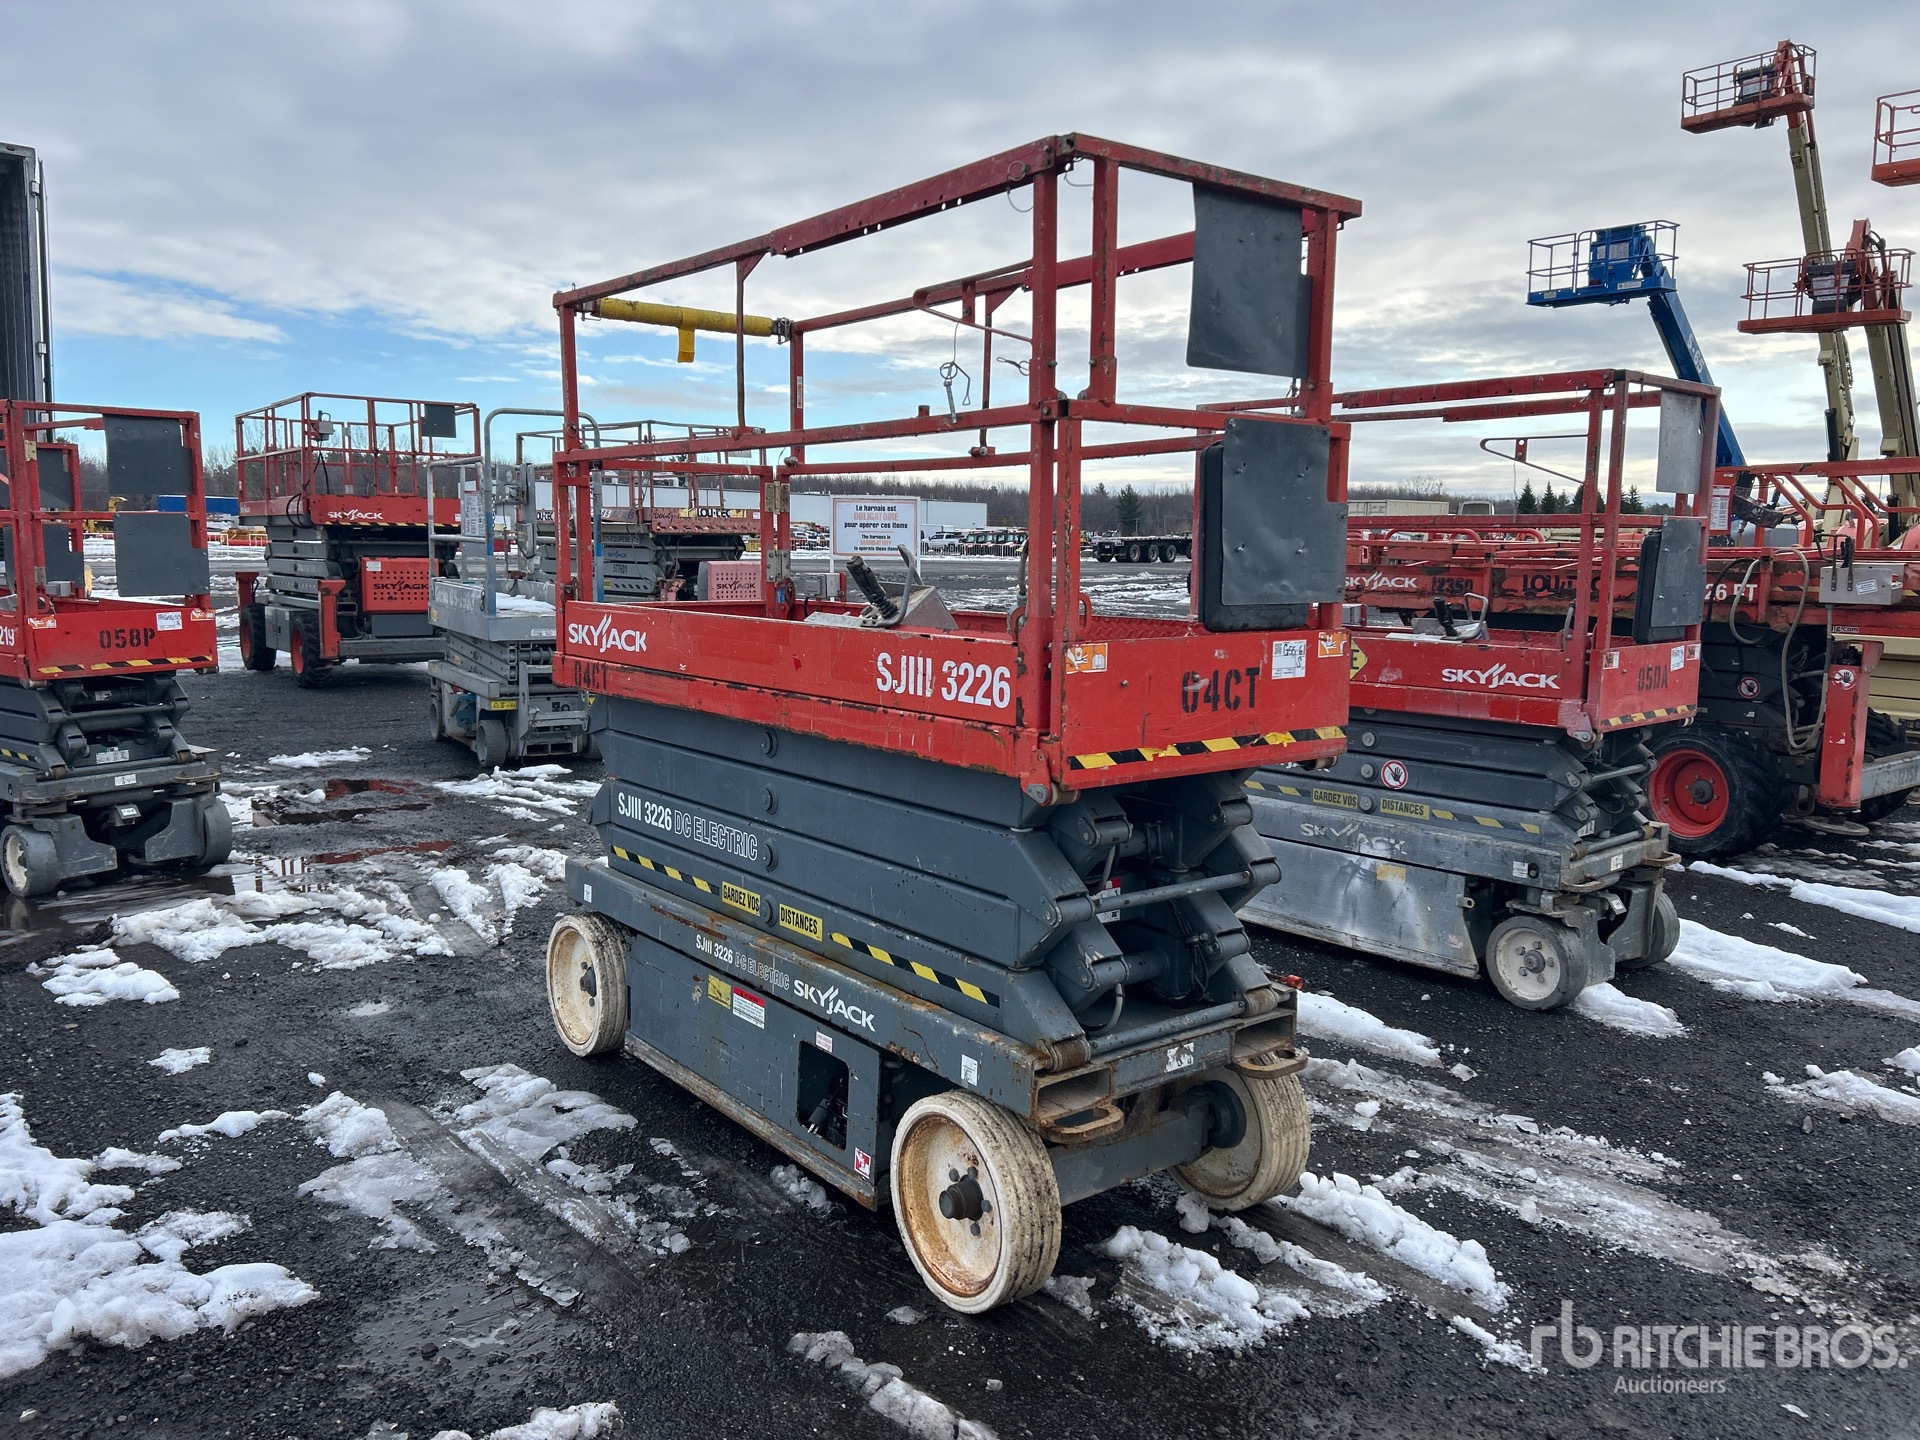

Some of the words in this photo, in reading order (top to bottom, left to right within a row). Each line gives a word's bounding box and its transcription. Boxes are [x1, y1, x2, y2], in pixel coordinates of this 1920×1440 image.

[327, 508, 384, 521] SKYJACK
[854, 512, 899, 521] OBLIGATOIRE
[373, 580, 429, 592] SKYJACK
[716, 581, 756, 591] SKYJACK
[99, 627, 156, 649] 058P
[568, 614, 647, 653] SKYJACK
[876, 652, 933, 698] SJIII
[941, 660, 1011, 709] 3226
[1441, 662, 1561, 690] SKYJACK
[1182, 667, 1261, 714] 04CT
[1313, 791, 1342, 806] GARDEZ
[1342, 795, 1357, 808] VOS
[1381, 800, 1425, 816] DISTANCES
[618, 791, 642, 821] SJIII
[644, 801, 672, 832] 3226
[674, 809, 692, 839] DC
[693, 815, 758, 861] ELECTRIC
[723, 884, 746, 905] GARDEZ
[747, 891, 760, 912] VOS
[780, 907, 818, 935] DISTANCES
[695, 934, 713, 956] SJIII
[713, 942, 734, 965] 3226
[747, 957, 790, 991] ELECTRIC
[793, 979, 876, 1032] SKYJACK
